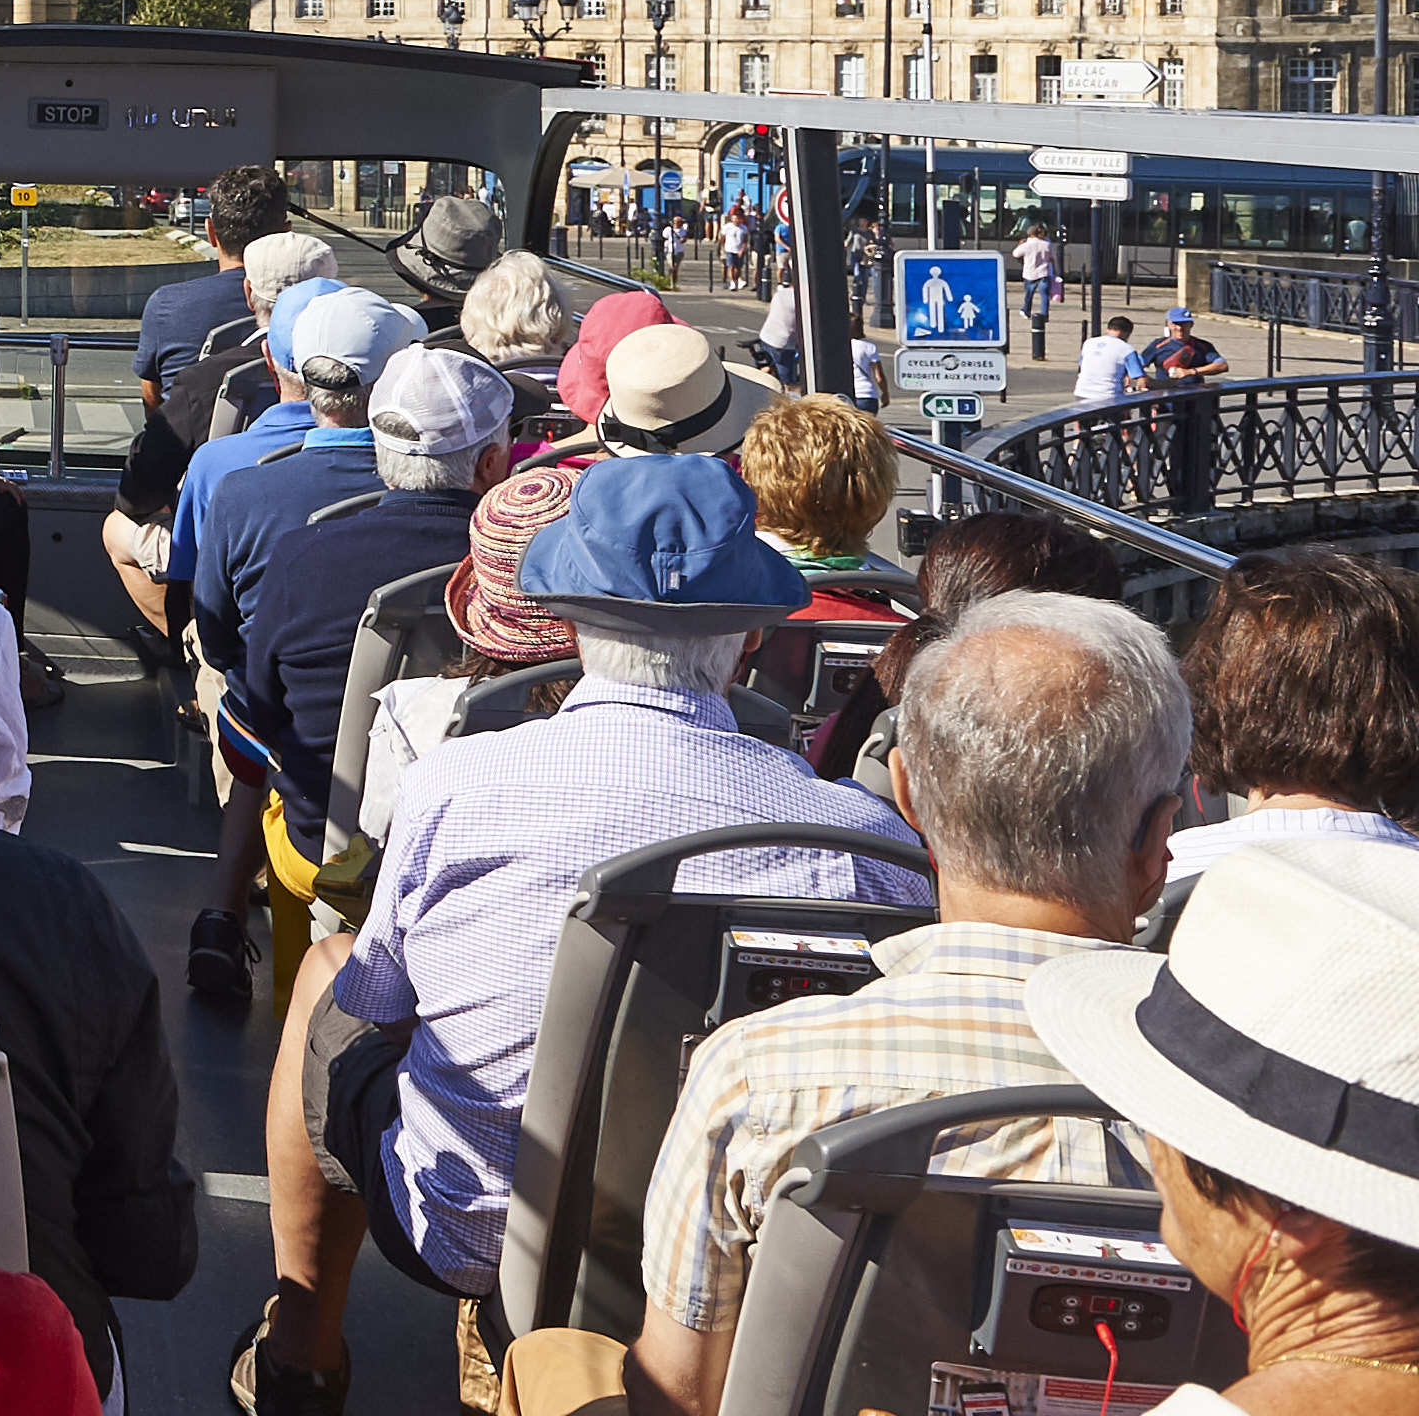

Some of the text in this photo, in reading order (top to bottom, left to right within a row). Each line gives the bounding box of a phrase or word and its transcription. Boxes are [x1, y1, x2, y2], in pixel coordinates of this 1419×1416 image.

[1067, 65, 1107, 75] LE LAC
[1067, 78, 1118, 88] BACALAN
[44, 106, 93, 123] STOP
[1043, 155, 1122, 168] CENTRE VILLE
[18, 192, 30, 201] 10
[901, 372, 941, 380] PRIORITÉ
[963, 372, 1001, 381] PIÉTONS
